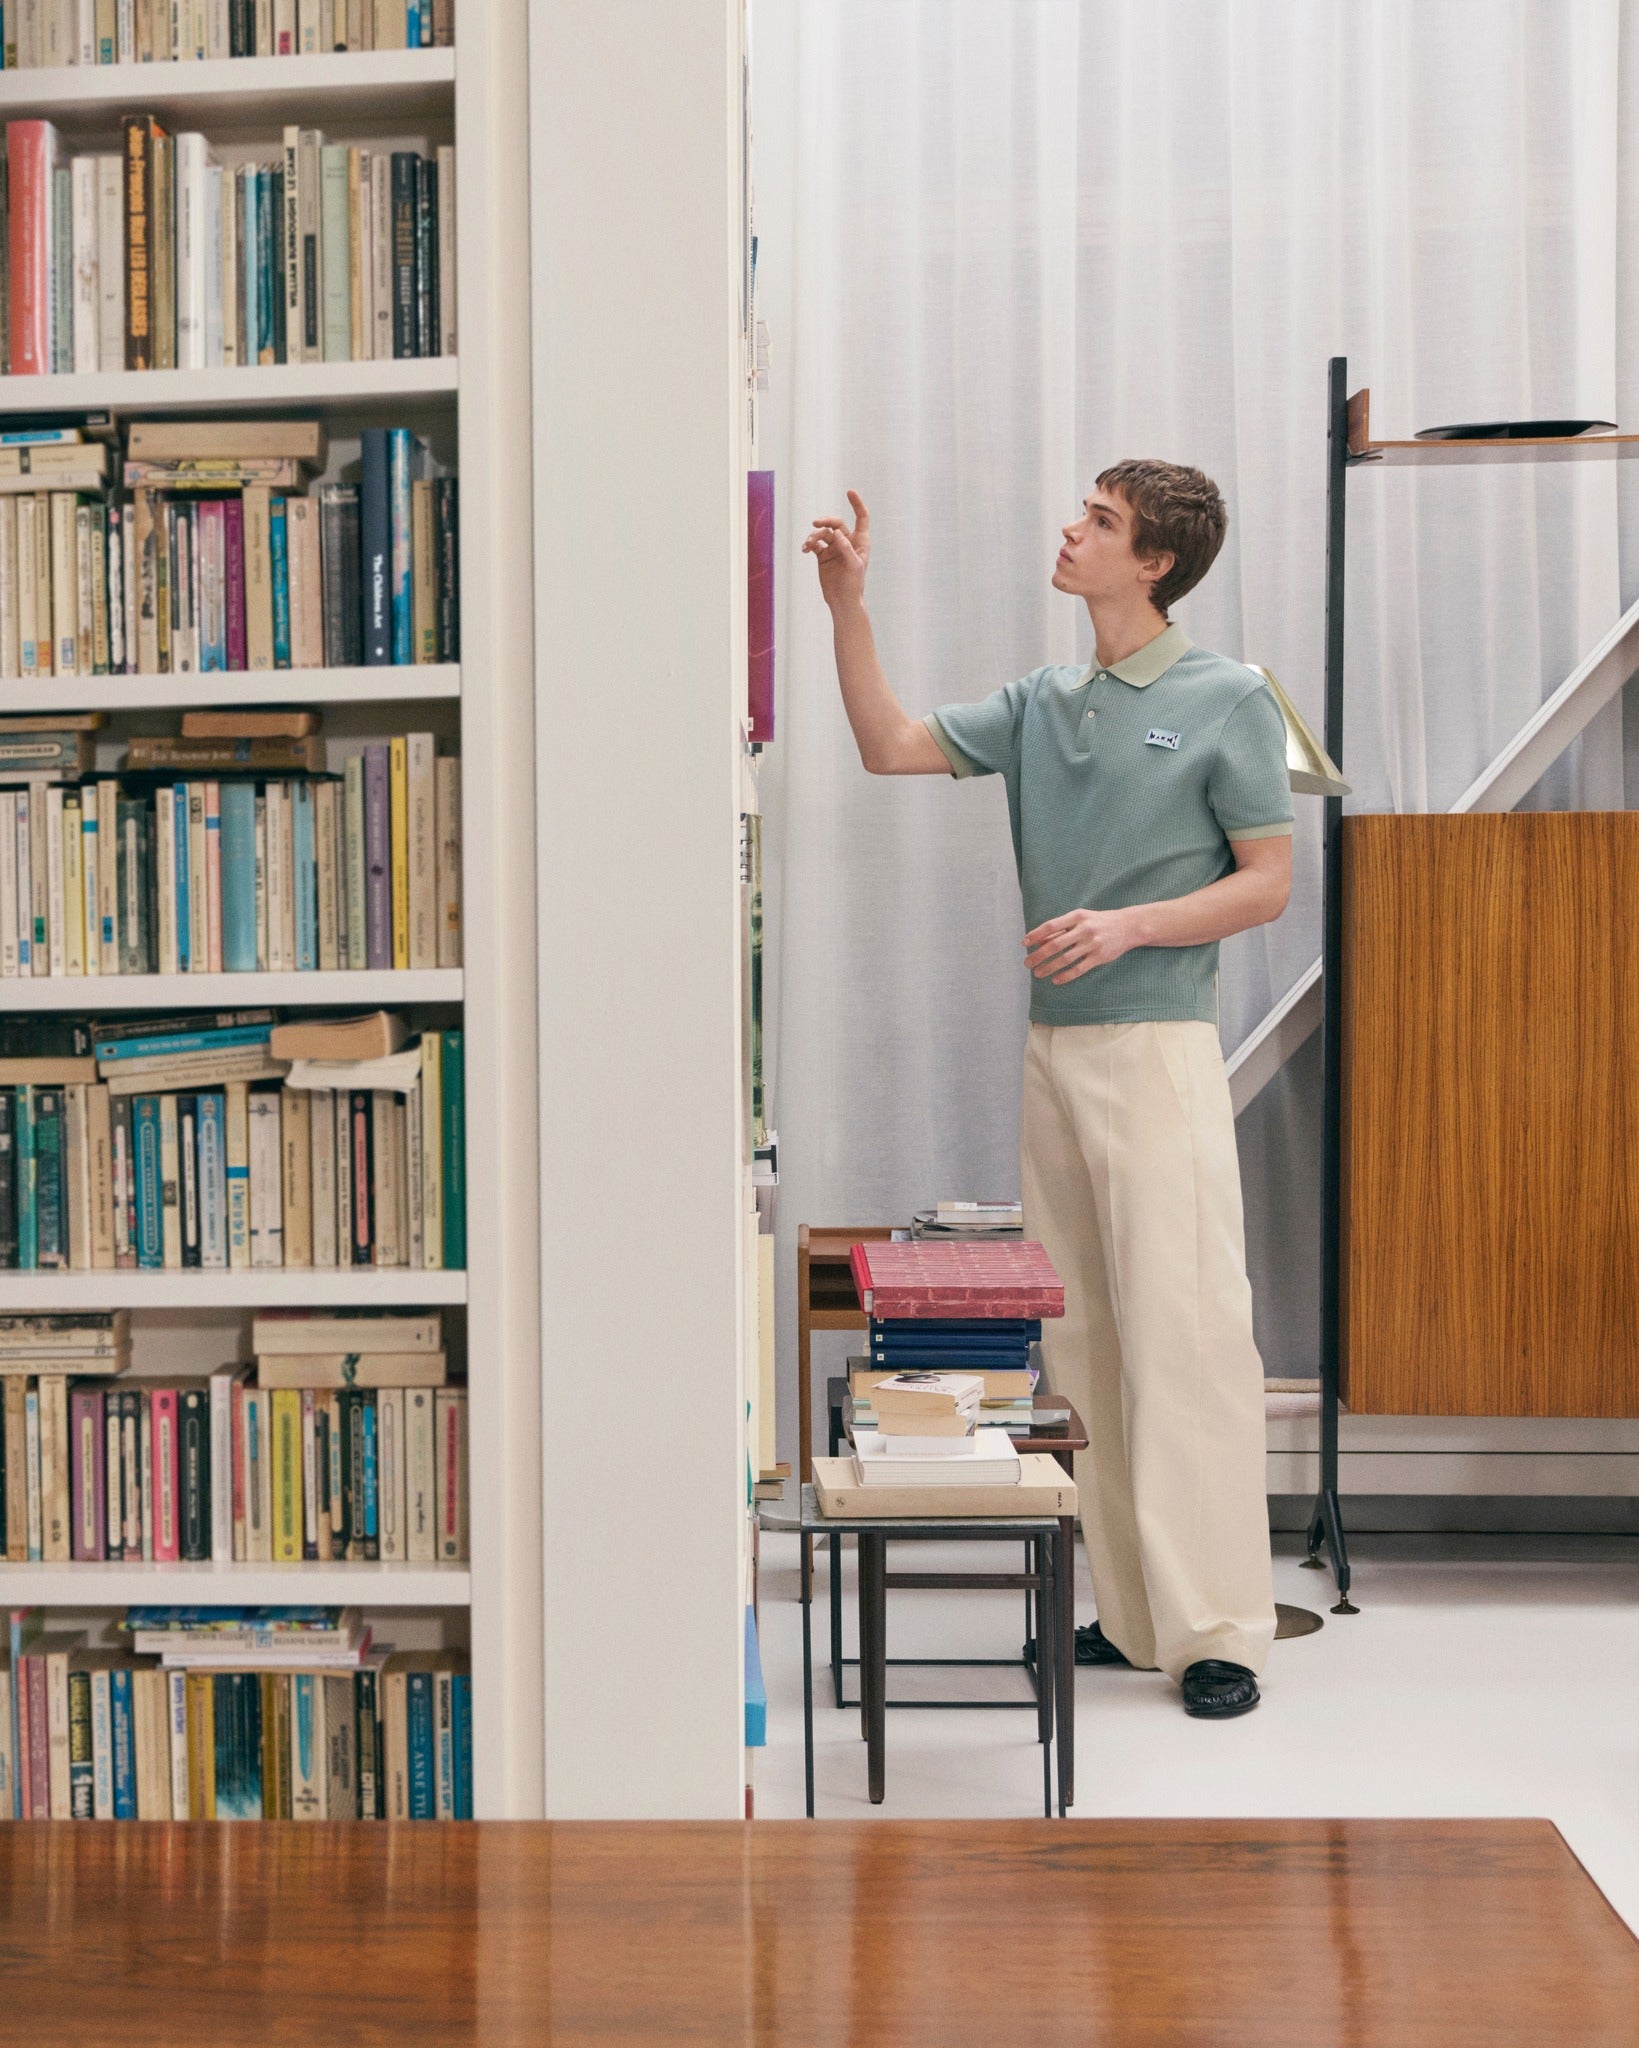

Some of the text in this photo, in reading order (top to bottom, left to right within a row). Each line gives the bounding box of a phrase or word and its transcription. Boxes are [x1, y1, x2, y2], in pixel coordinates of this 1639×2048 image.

[287, 197, 296, 259] BURROUGHS
[288, 263, 297, 308] WILLIAM
[373, 554, 384, 628] The Children Art
[440, 1680, 449, 1729] DEIGHTON
[415, 1751, 425, 1817] ANNE TYL
